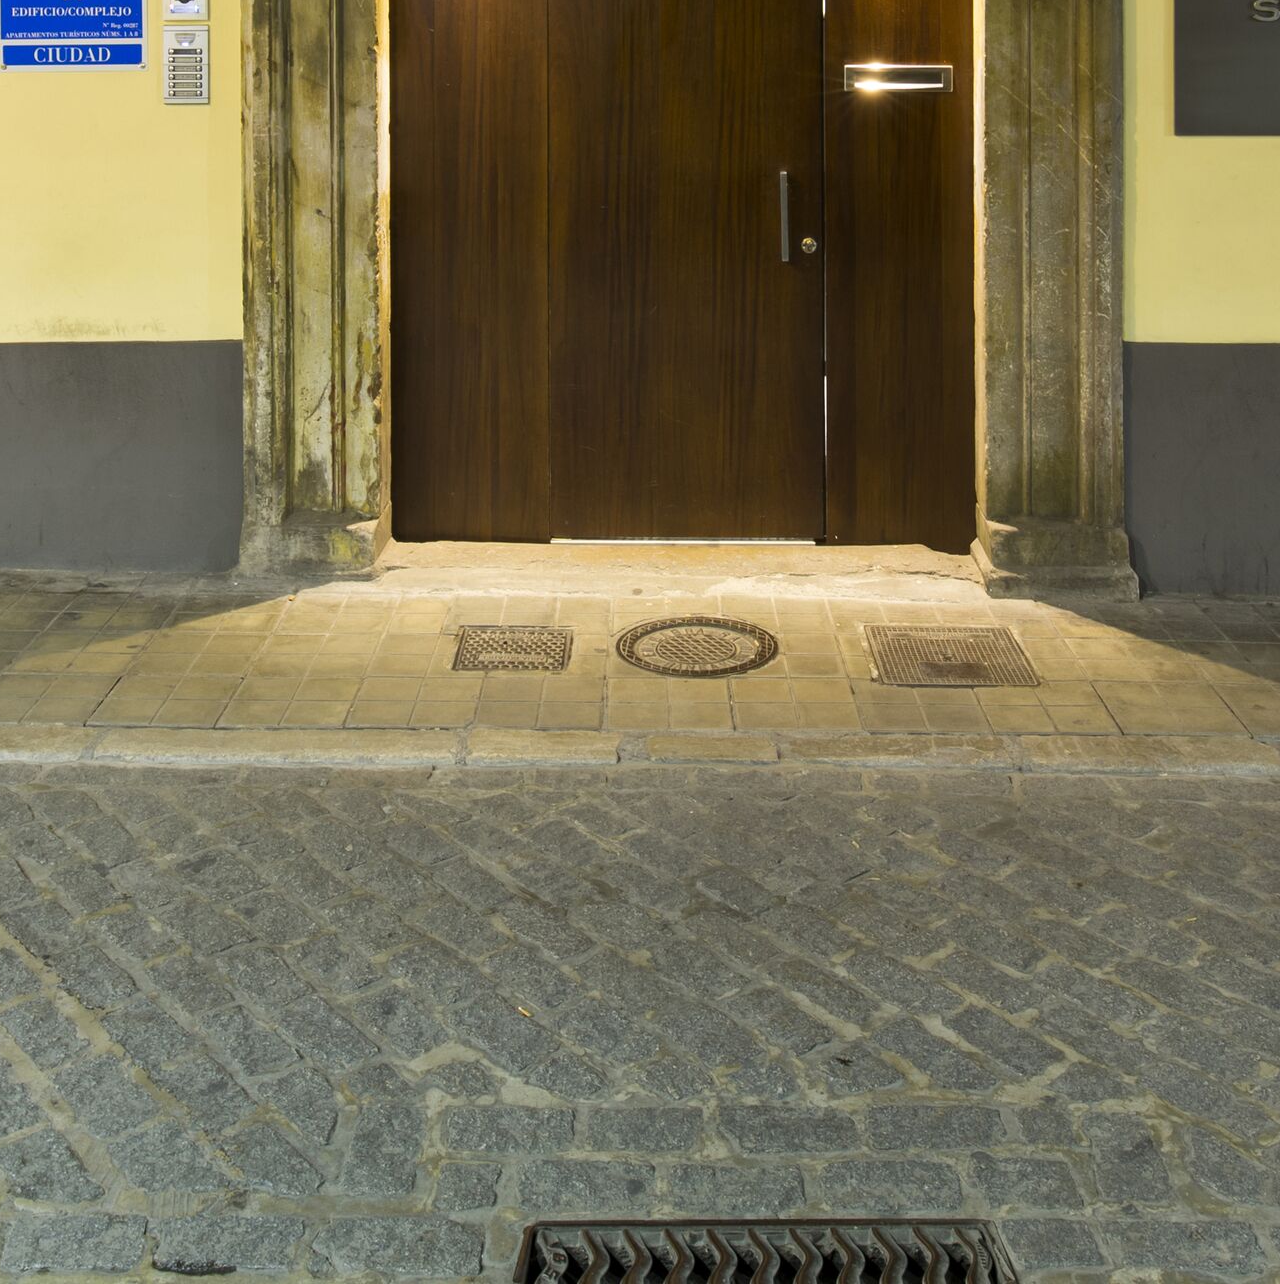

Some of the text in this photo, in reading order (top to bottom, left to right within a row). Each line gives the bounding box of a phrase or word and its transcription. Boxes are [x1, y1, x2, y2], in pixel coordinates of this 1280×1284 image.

[11, 6, 133, 17] EDIFICIO/COMPLEJO
[59, 30, 100, 38] TURÍSTICOS
[33, 46, 112, 63] CIUDAD
